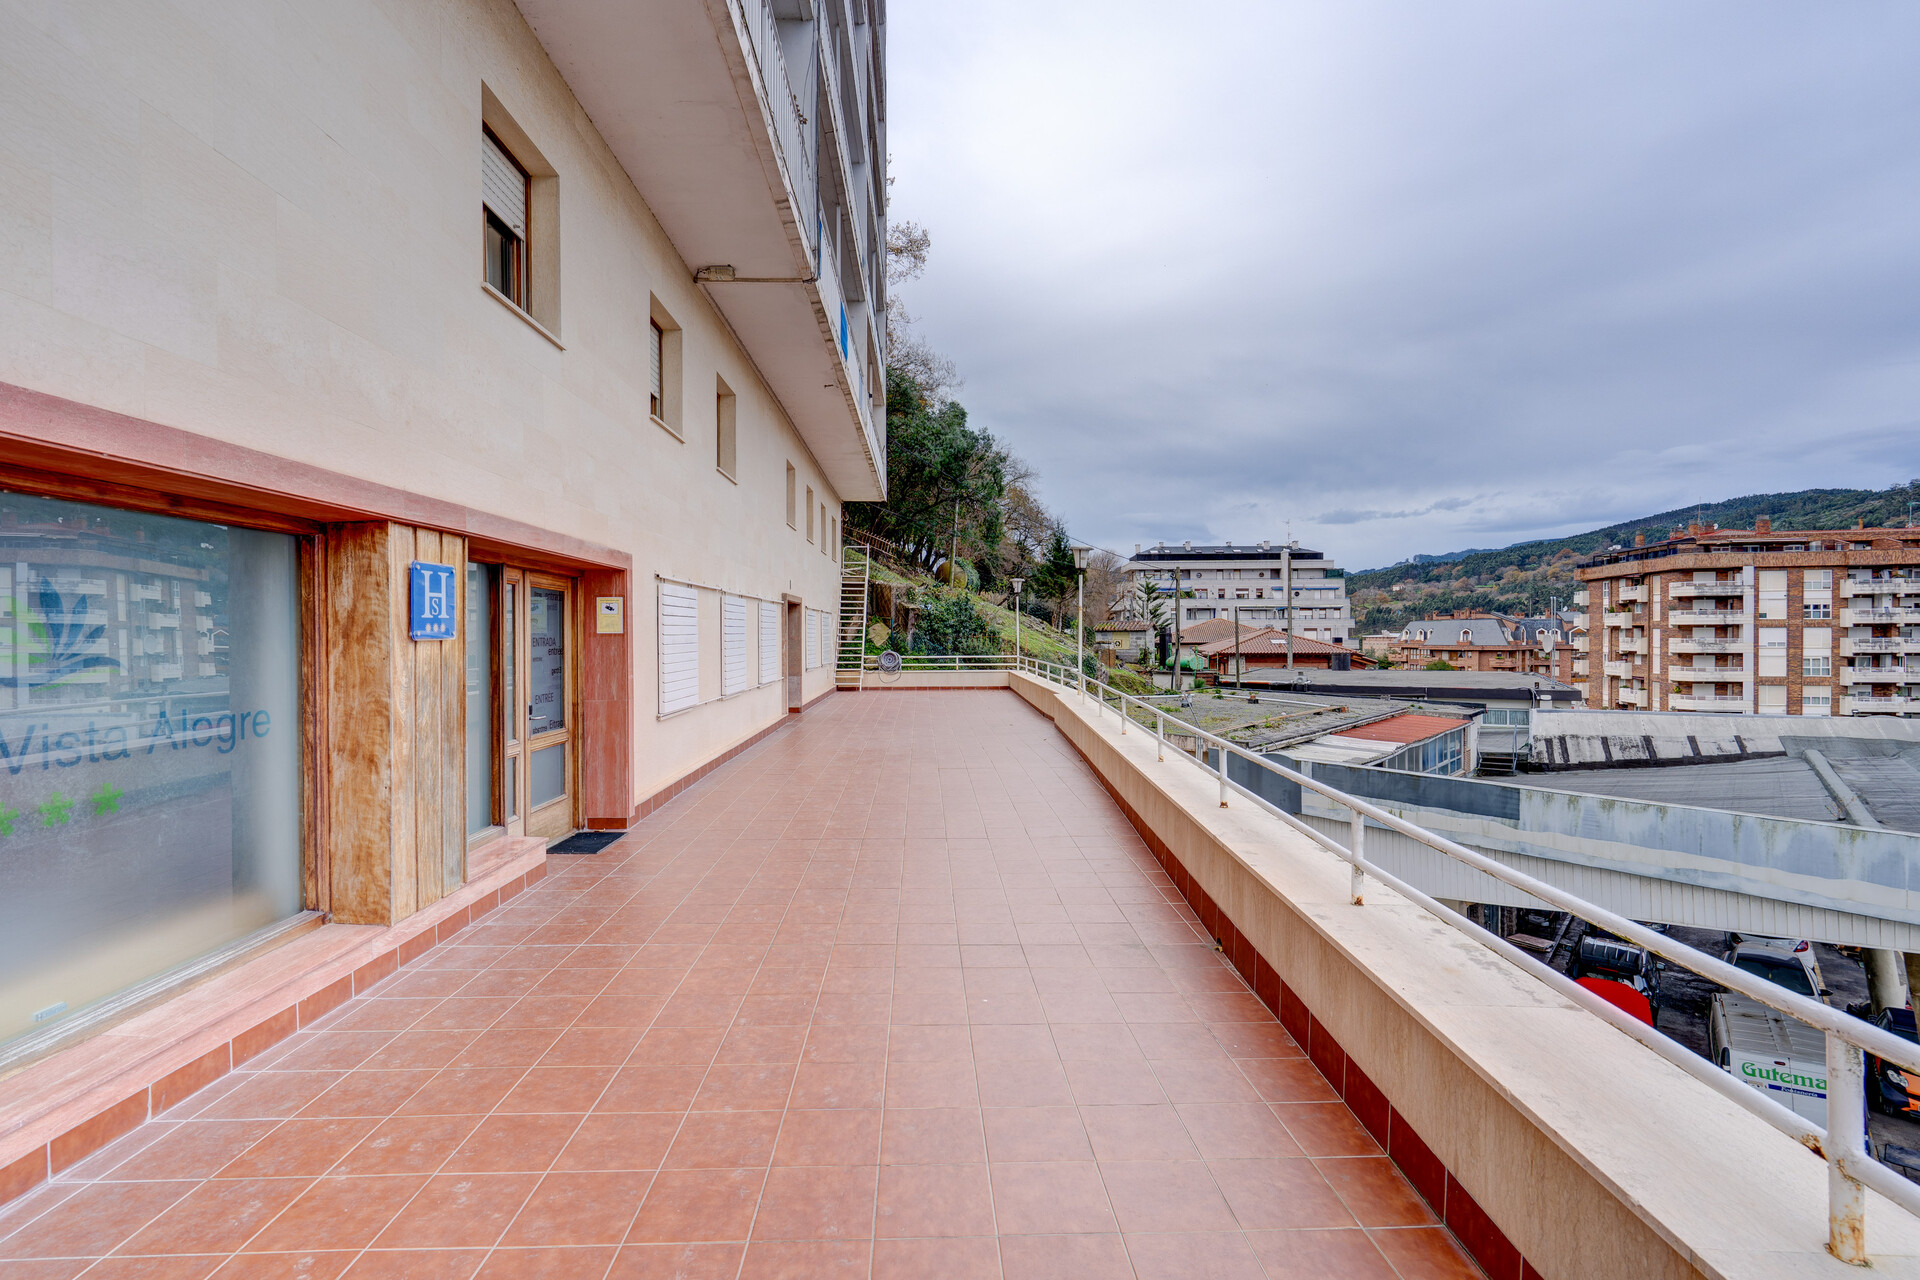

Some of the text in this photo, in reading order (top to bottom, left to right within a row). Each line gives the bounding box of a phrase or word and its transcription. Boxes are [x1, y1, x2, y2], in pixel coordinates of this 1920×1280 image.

[533, 637, 556, 647] ENTRADA
[0, 708, 272, 775] Vista Alegre
